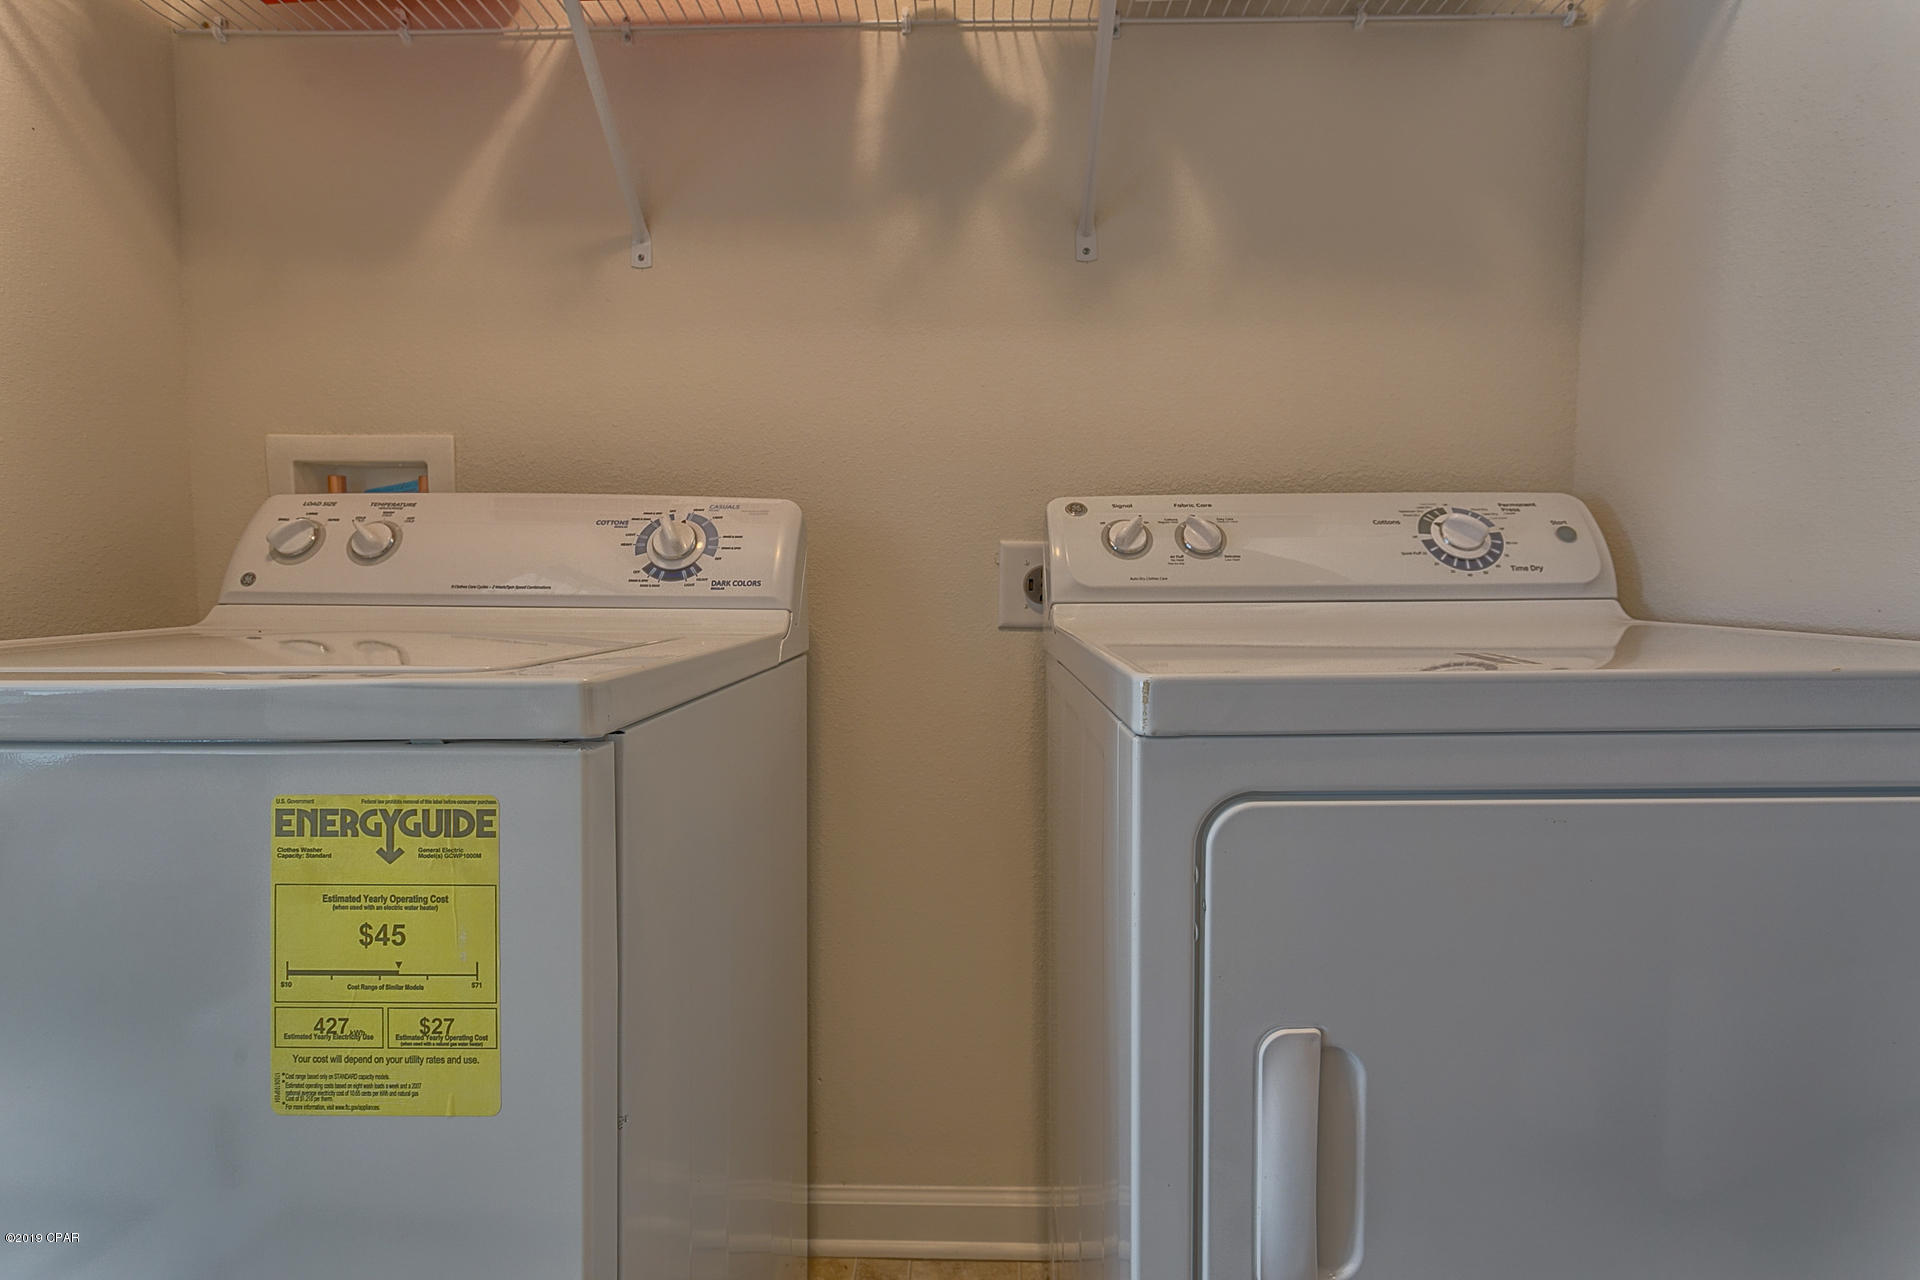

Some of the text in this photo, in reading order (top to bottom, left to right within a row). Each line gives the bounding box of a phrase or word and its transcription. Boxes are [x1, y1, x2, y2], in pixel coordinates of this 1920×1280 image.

[1530, 565, 1544, 573] Dry
[275, 808, 497, 839] ENERGYGUIDE
[322, 894, 449, 905] Estimated Yearly Operating Cost
[332, 904, 349, 912] (when
[419, 904, 438, 912] heater)
[359, 921, 407, 949] $45
[313, 1017, 350, 1035] 427
[419, 1017, 455, 1037] $27
[314, 1033, 332, 1042] Yearly
[332, 1033, 361, 1042] Electricity
[425, 1034, 443, 1043] Yearly
[444, 1034, 474, 1043] Operating
[292, 1054, 311, 1063] Your
[312, 1054, 328, 1063] cost
[330, 1054, 342, 1063] will
[344, 1054, 372, 1065] depend
[385, 1056, 404, 1065] your
[404, 1055, 424, 1066] utility
[426, 1055, 445, 1064] rates
[446, 1055, 461, 1064] and
[462, 1056, 480, 1065] use.
